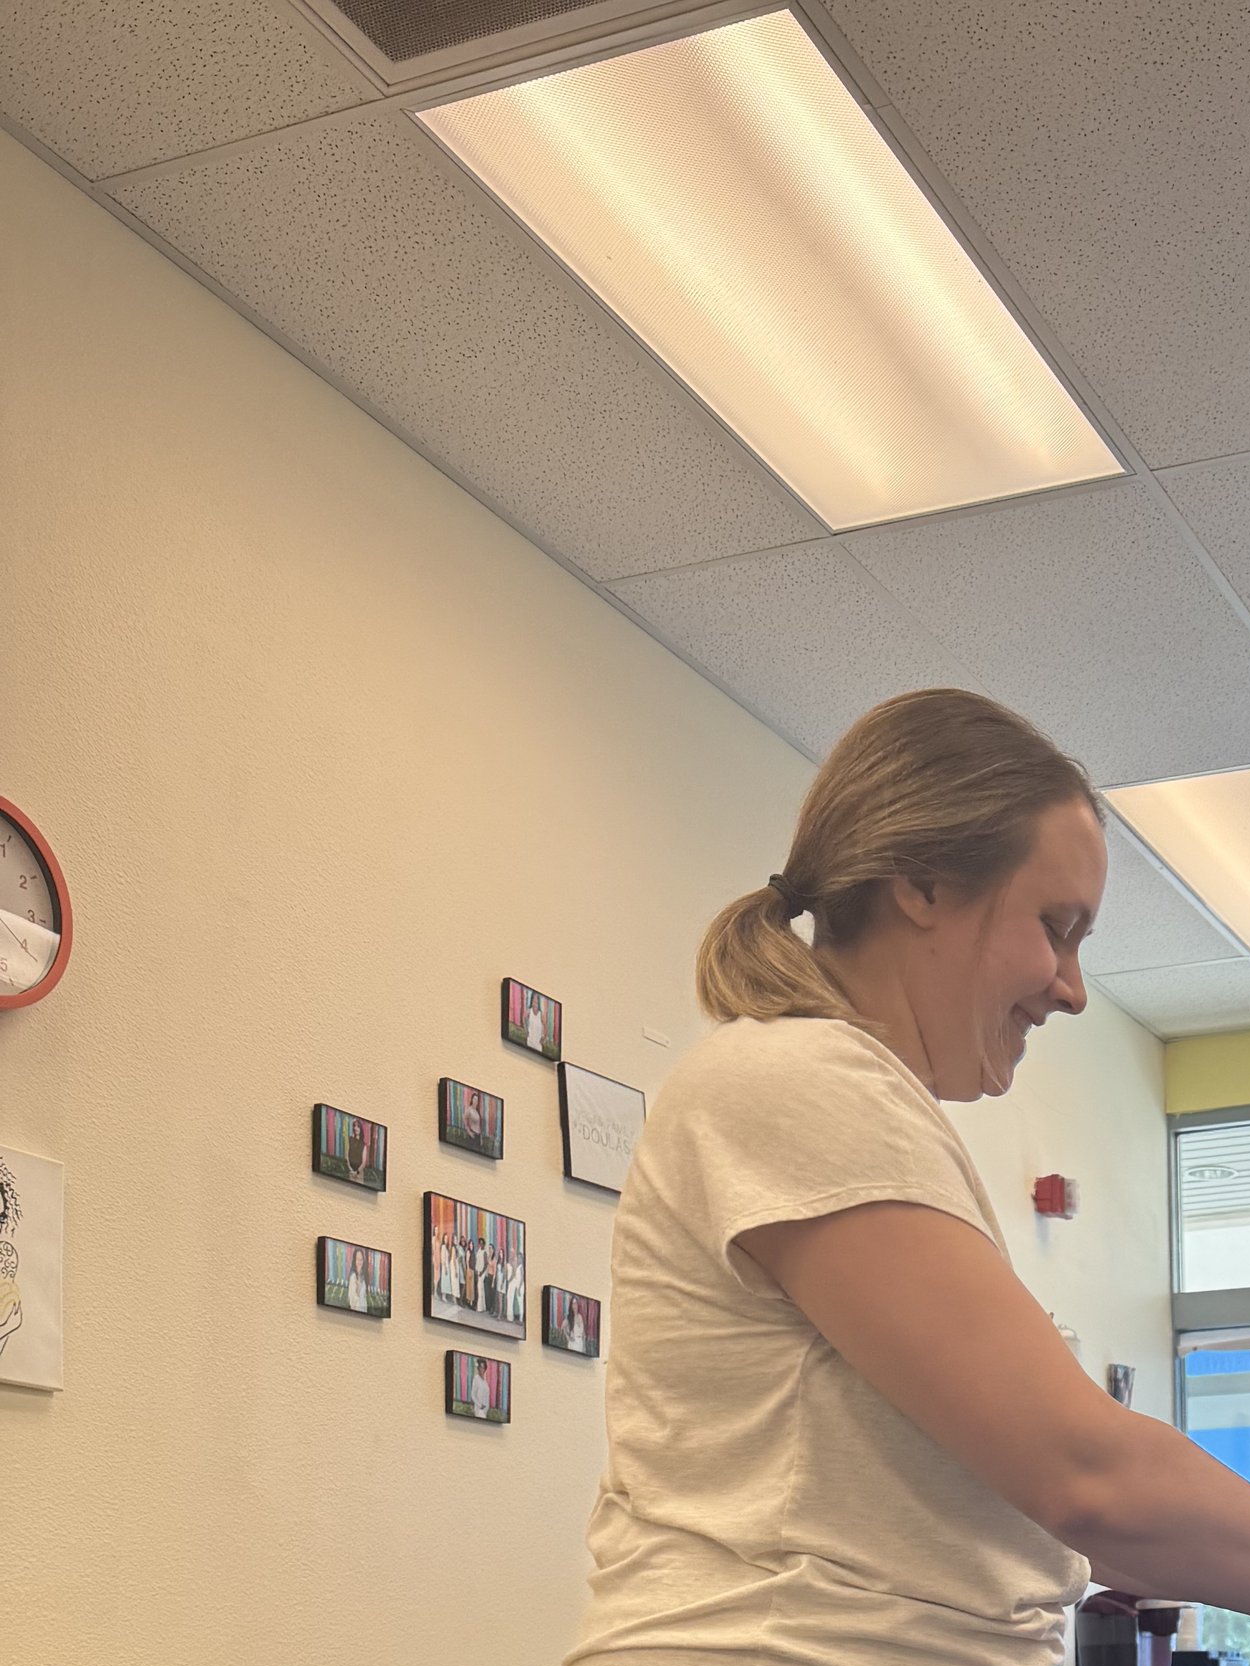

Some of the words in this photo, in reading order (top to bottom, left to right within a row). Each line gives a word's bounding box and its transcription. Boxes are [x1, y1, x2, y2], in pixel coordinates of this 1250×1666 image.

[19, 874, 28, 890] 2
[27, 909, 36, 924] 3
[20, 938, 29, 951] 4
[582, 1123, 632, 1156] DOULAS
